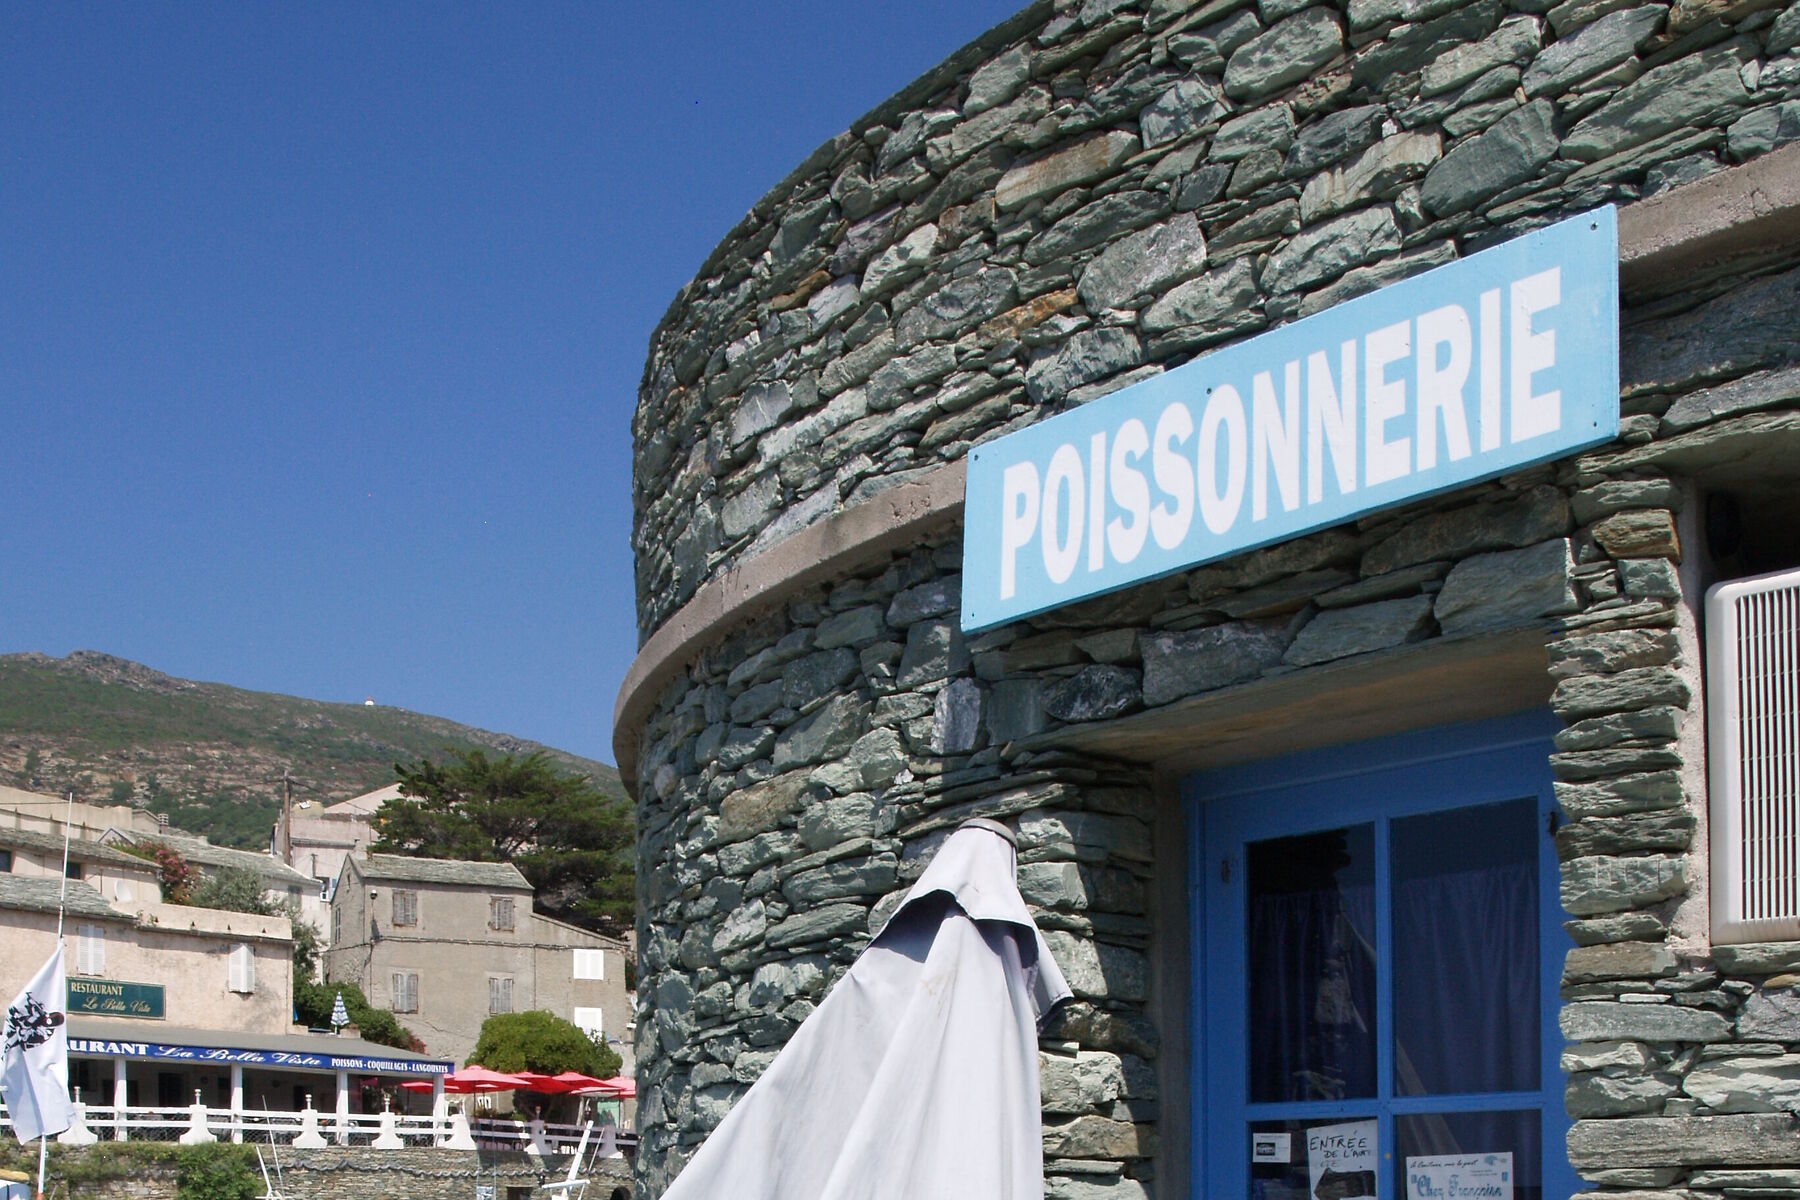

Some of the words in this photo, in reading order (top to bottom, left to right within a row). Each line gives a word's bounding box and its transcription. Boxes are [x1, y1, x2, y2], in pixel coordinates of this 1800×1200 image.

[1000, 266, 1561, 600] POISSONNERIE
[71, 982, 123, 996] RESTAURANT
[154, 1046, 194, 1058] La
[200, 1049, 266, 1062] Bella
[272, 1053, 322, 1065] Vista
[331, 1058, 363, 1068] POISSONS
[367, 1060, 408, 1071] COQUILLAGES
[412, 1063, 449, 1073] LANGOUSTES
[1310, 1130, 1367, 1151] ENTRÉE
[1323, 1150, 1338, 1159] DE
